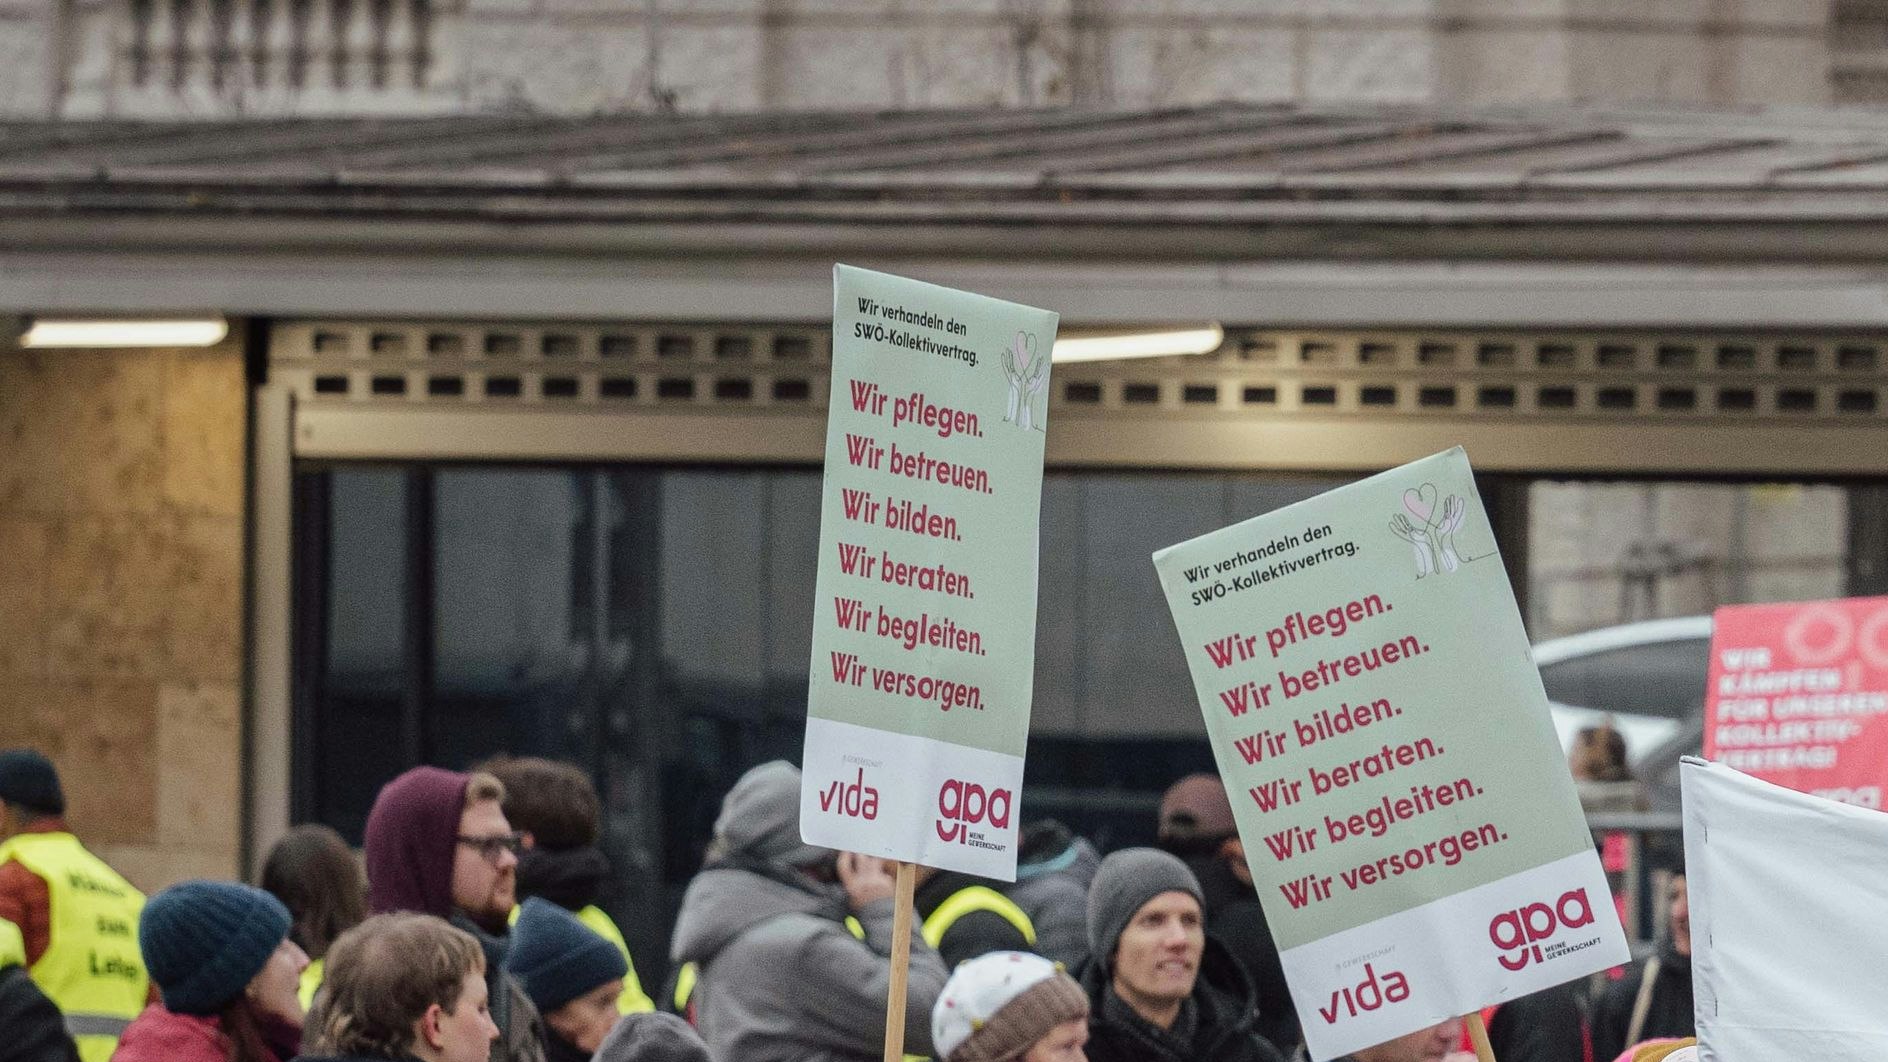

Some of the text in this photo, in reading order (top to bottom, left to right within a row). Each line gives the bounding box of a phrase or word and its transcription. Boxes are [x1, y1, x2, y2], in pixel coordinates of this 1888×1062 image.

[854, 322, 979, 368] SWÖ-Kollektivvertrag.
[857, 296, 967, 337] Wir verhandeln den
[850, 379, 984, 438] Wir pflegen.
[846, 433, 994, 495] Wir betreuen.
[842, 488, 962, 541] Wir bilden.
[838, 542, 975, 599] Wir beraten.
[1183, 523, 1334, 585] Wir verhandeln den
[1190, 542, 1361, 606] SWÖ-Kollektivvertrag.
[834, 596, 986, 657] Wir begleiten.
[1204, 593, 1393, 670] Wir pflegen.
[830, 651, 985, 712] Wir versorgen.
[1219, 634, 1431, 718] Wir betreuen.
[1233, 698, 1403, 767] Wir bilden.
[819, 767, 879, 821] vida
[1248, 735, 1445, 814] Wir beraten.
[936, 778, 1011, 845] gpa
[1263, 776, 1485, 863] Wir begleiten.
[1278, 822, 1509, 910] Wir versorgen.
[1489, 887, 1595, 971] gpa
[1544, 940, 1567, 954] MEINE
[1546, 936, 1601, 961] GEWERKSCHAFT
[1318, 963, 1410, 1025] vida
